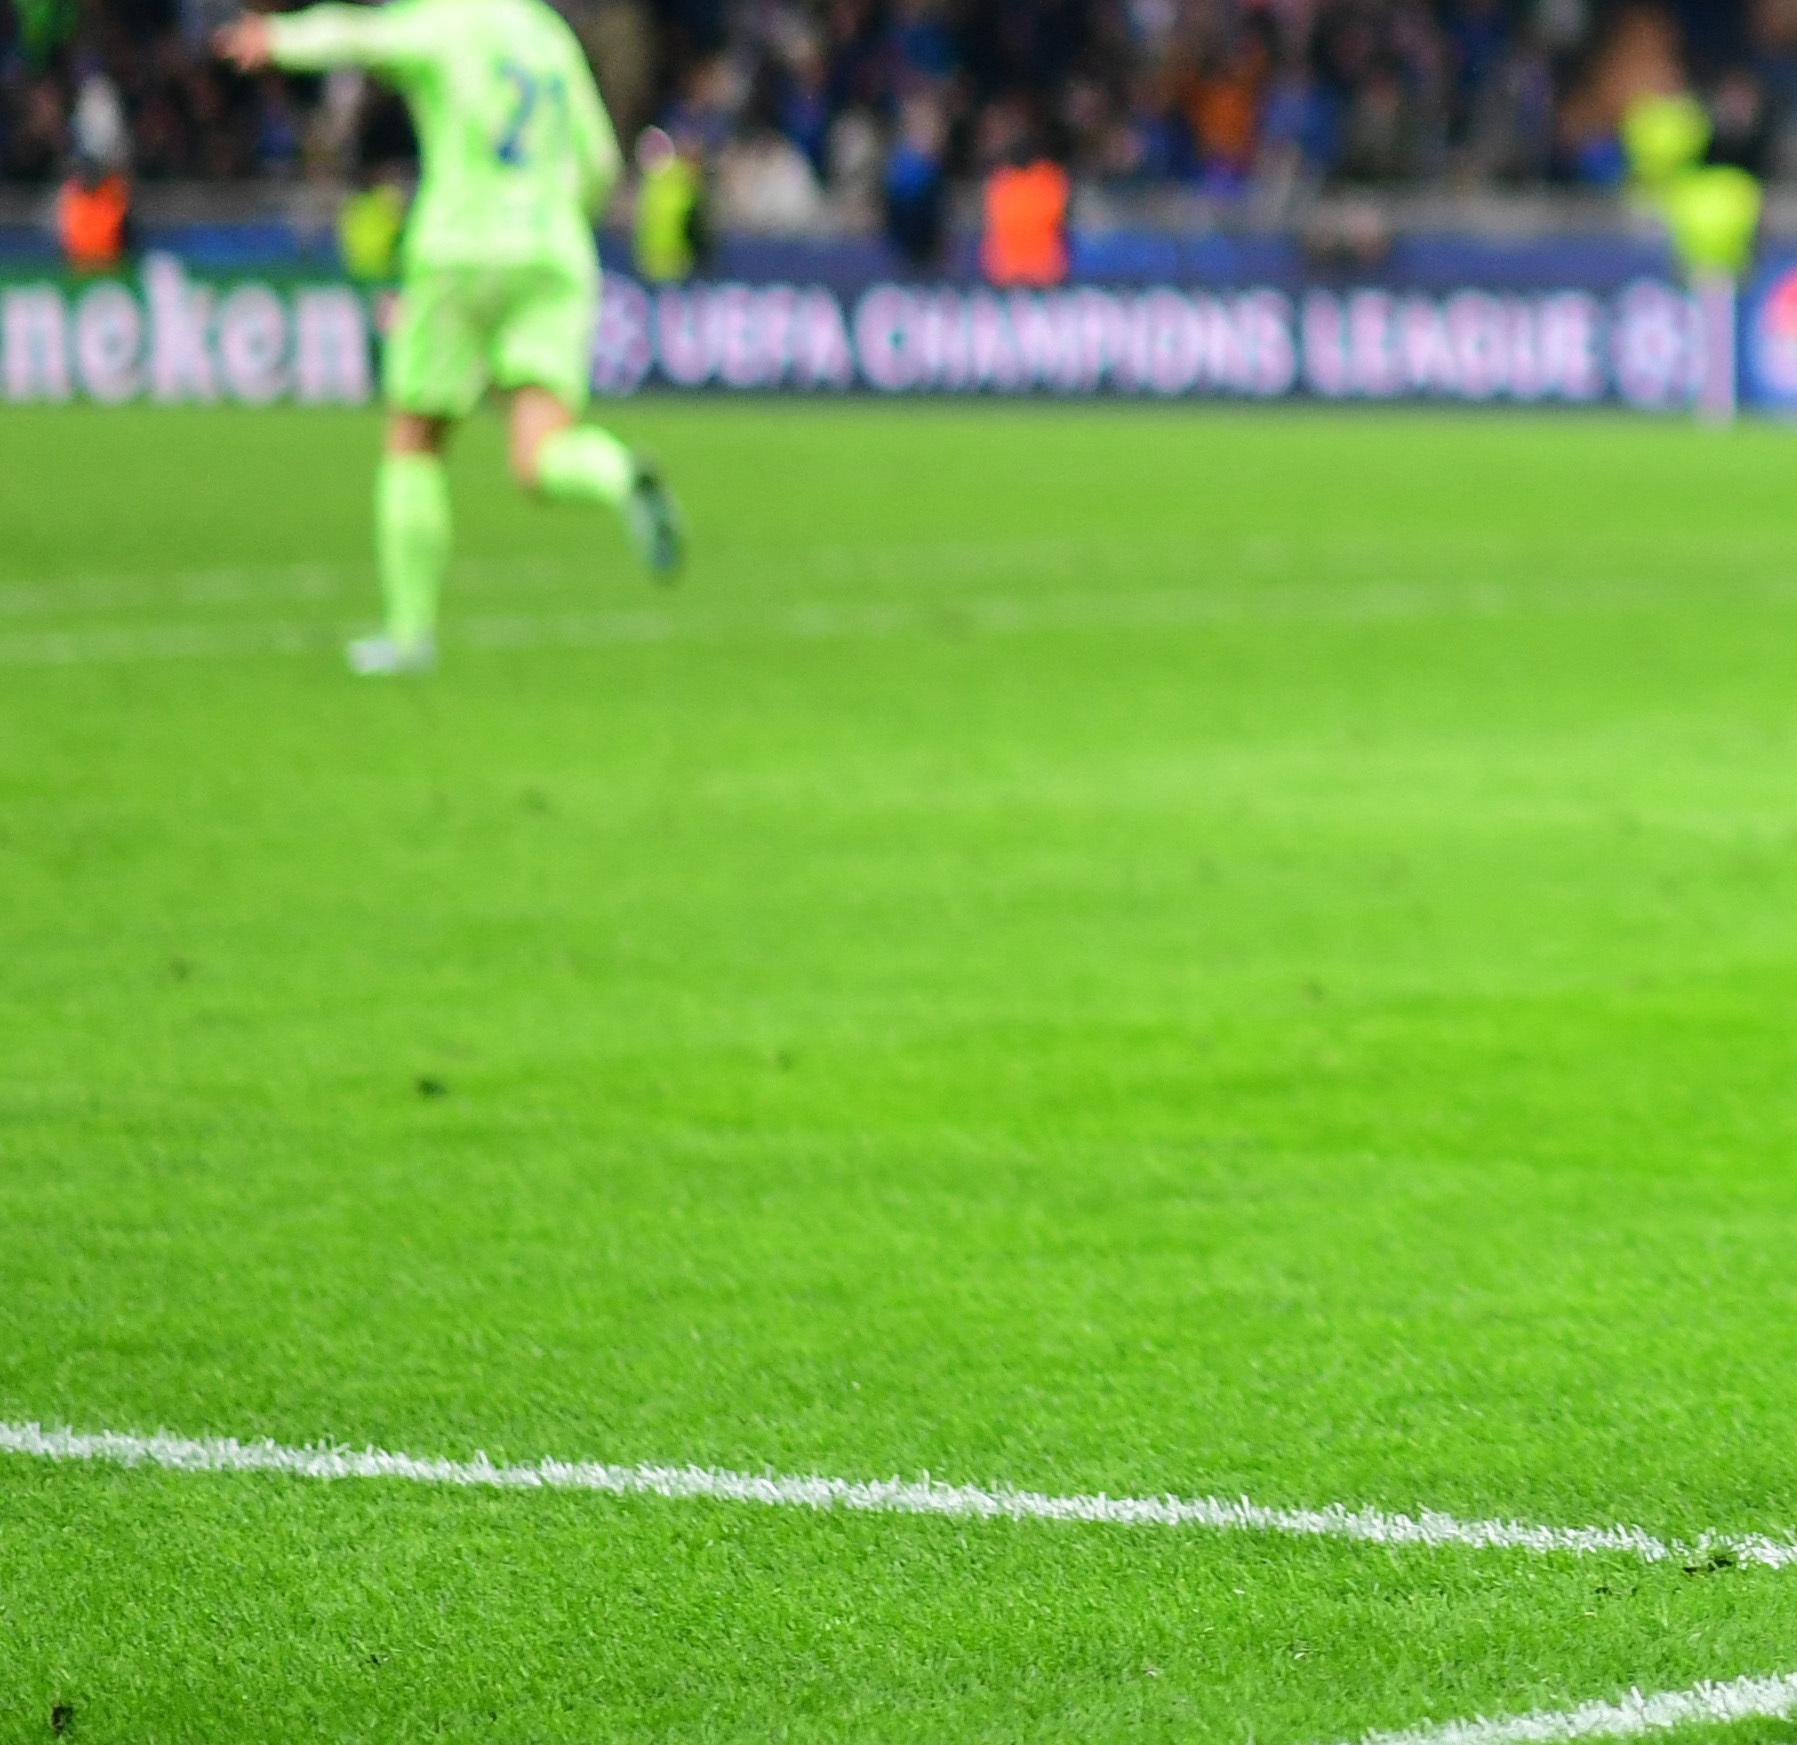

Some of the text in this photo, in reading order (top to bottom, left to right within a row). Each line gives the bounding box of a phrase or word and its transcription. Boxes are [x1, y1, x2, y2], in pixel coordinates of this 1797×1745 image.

[656, 281, 1602, 398] UEFA CHAMPIONS LEAGUE
